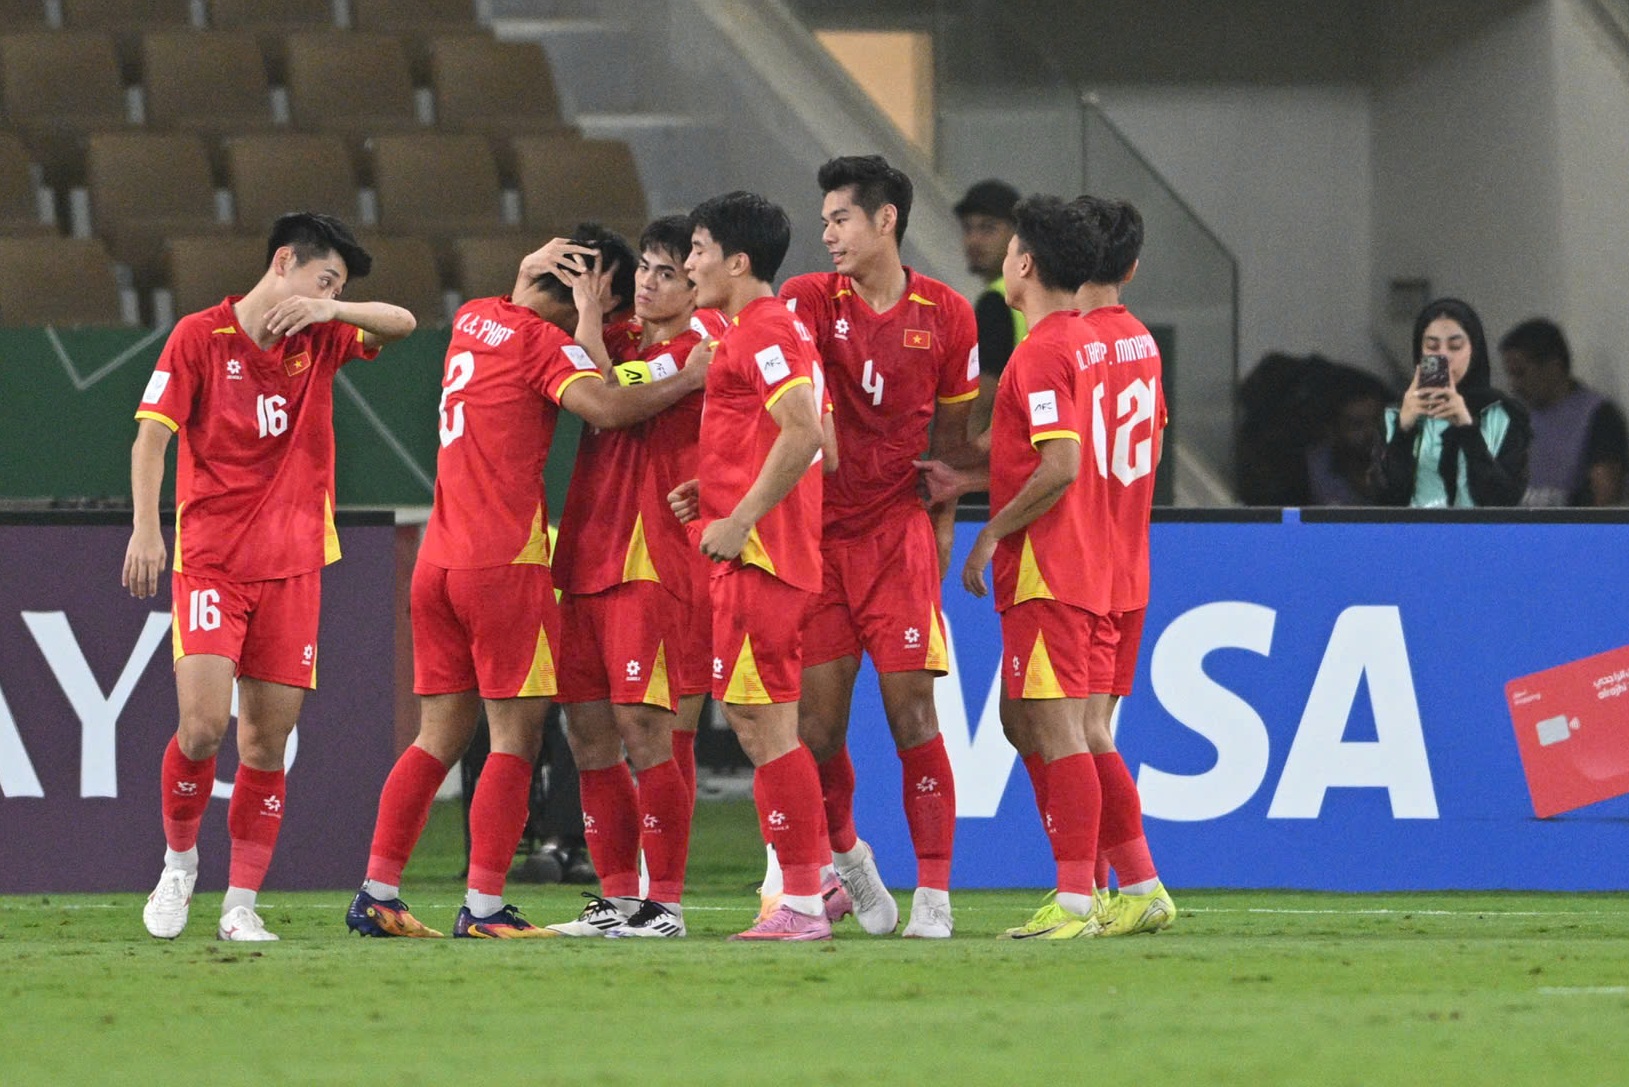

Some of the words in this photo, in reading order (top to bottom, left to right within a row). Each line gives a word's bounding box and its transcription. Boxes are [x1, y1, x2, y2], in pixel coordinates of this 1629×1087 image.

[862, 360, 883, 405] 4
[257, 395, 288, 437] 16
[1034, 401, 1053, 412] AFC
[189, 589, 220, 632] 16
[932, 601, 1439, 821] VSA
